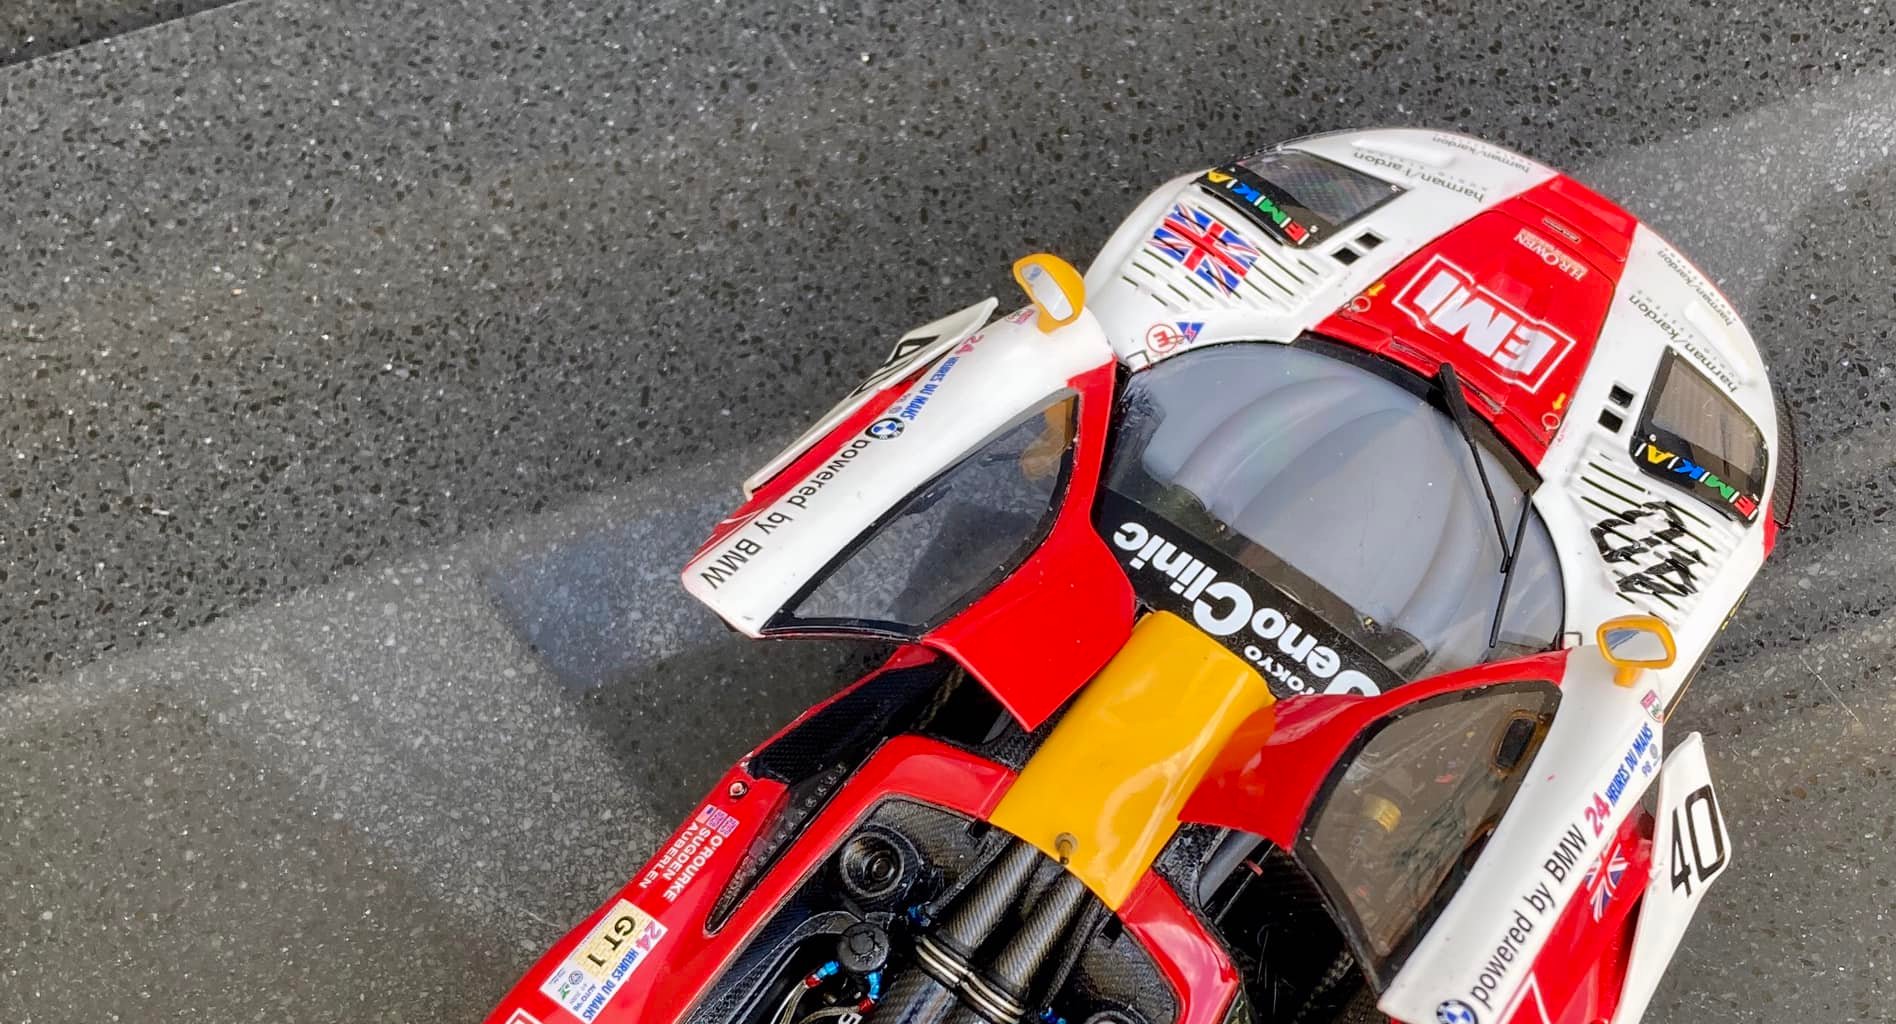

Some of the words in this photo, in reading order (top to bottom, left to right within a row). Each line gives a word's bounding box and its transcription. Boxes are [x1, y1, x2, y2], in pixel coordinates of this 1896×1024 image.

[1412, 269, 1557, 376] EMI
[1628, 294, 1740, 393] harman/kardon
[901, 394, 930, 421] MANS
[787, 439, 871, 510] powered
[754, 511, 794, 535] by
[700, 538, 763, 590] BMW
[1584, 791, 1612, 838] 24
[1632, 722, 1654, 760] MANS
[638, 821, 699, 889] AUBERLEN
[662, 827, 712, 881] SUGDEN
[1670, 785, 1725, 897] 40
[663, 835, 723, 902] O'ROURKE
[604, 915, 636, 952] GT
[635, 920, 662, 952] 24
[1470, 910, 1536, 1012] powered
[1523, 882, 1556, 914] by
[1543, 824, 1590, 884] BMW
[587, 953, 607, 968] 1
[611, 948, 640, 982] HEURES
[582, 992, 606, 1022] MANS
[601, 979, 616, 996] DU
